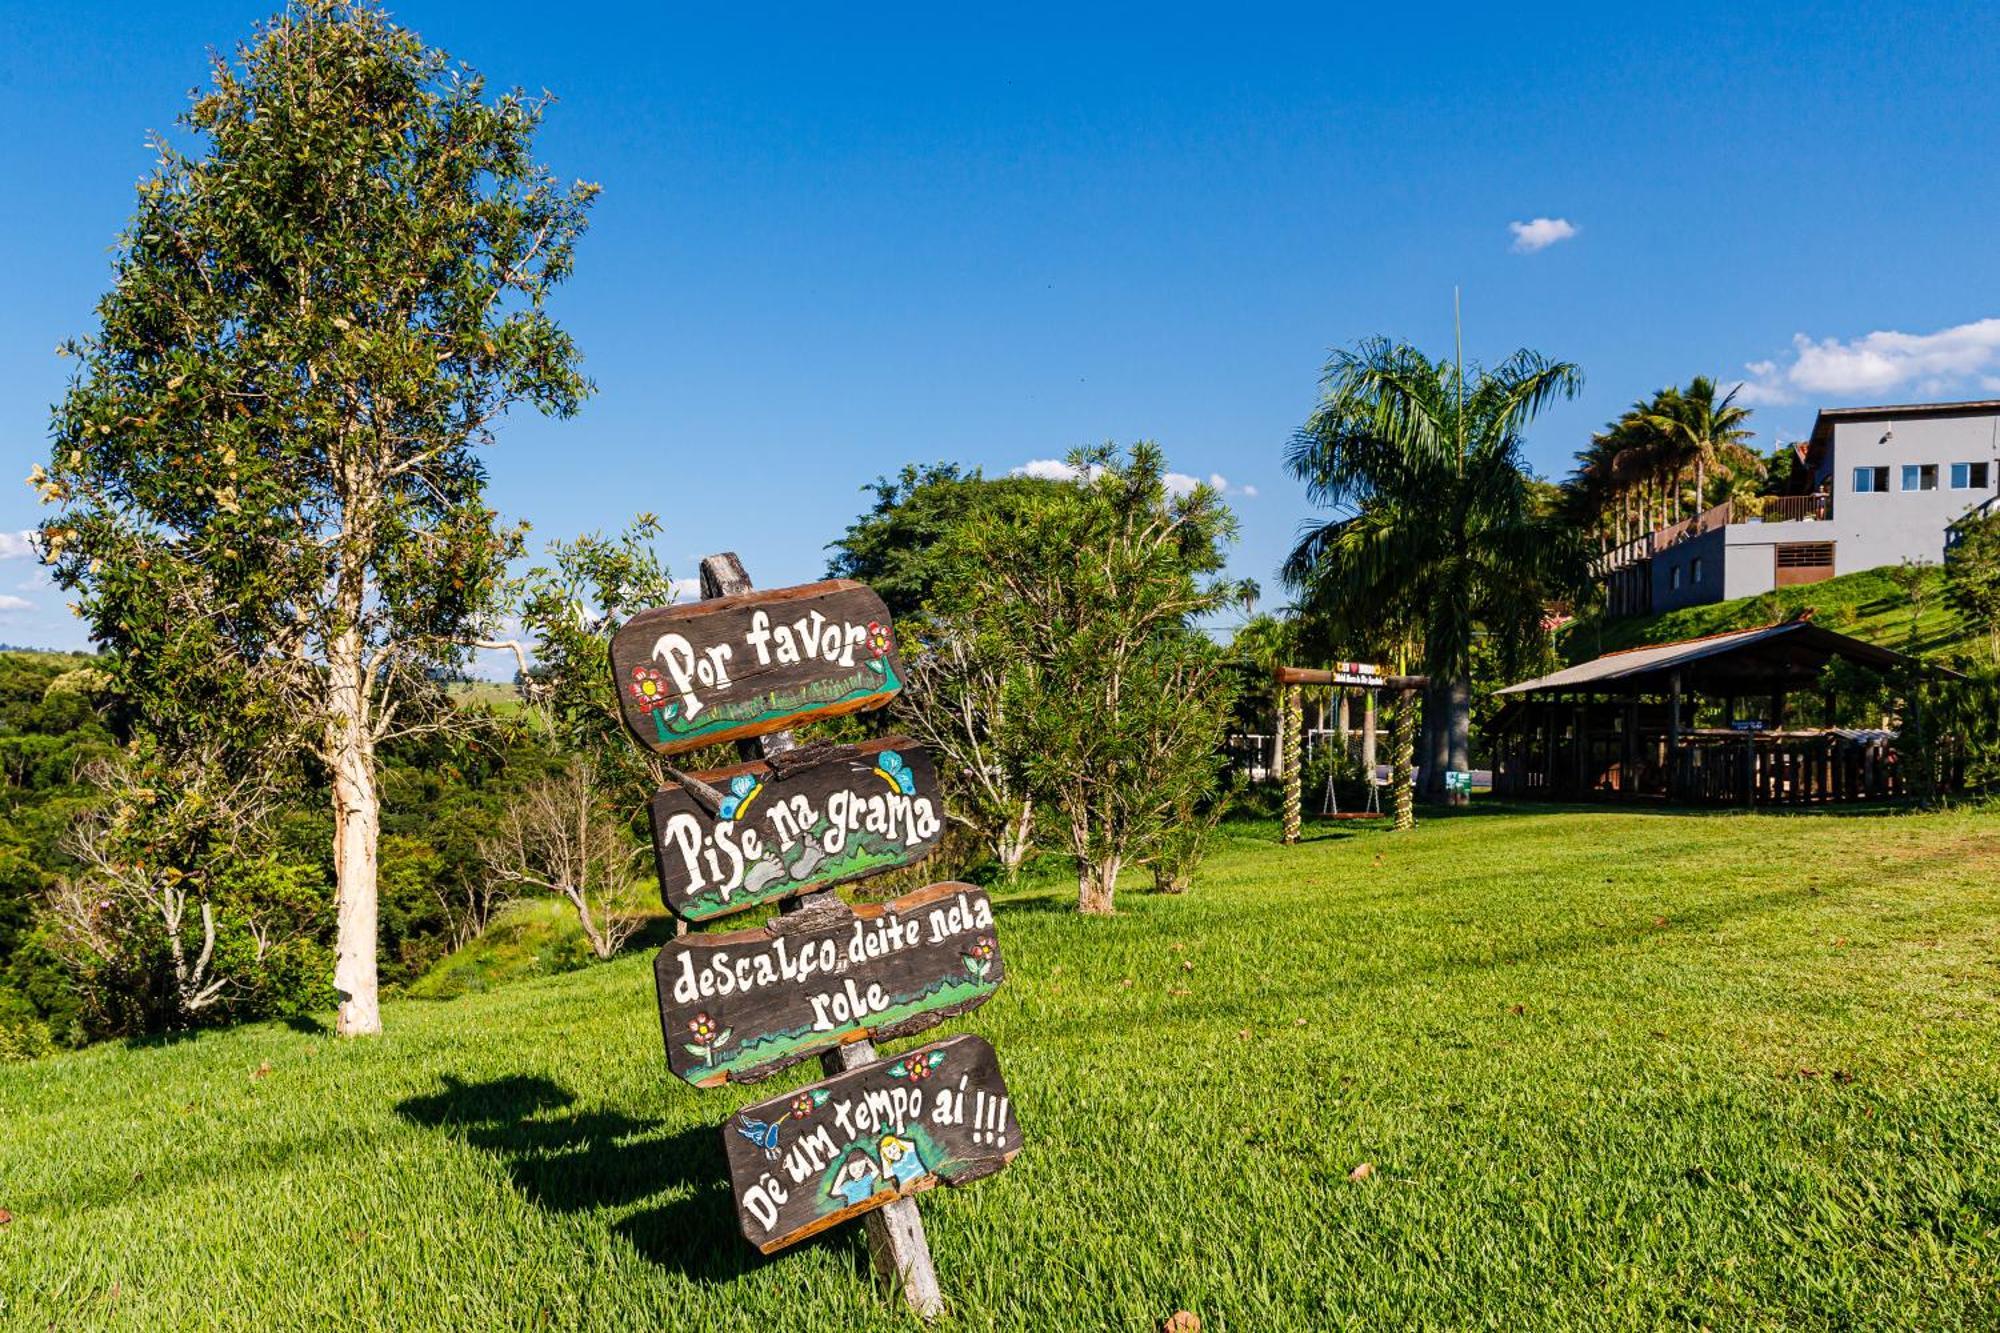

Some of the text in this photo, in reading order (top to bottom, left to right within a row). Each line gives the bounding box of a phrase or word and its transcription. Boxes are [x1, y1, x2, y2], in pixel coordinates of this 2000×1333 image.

[652, 609, 868, 722] Por favor
[664, 789, 941, 901] Pise na grama
[848, 915, 920, 963] deite
[926, 893, 994, 945] nela
[810, 979, 890, 1032] role
[782, 1124, 841, 1183] um
[833, 1086, 923, 1140] tempo
[931, 1075, 969, 1125] aí
